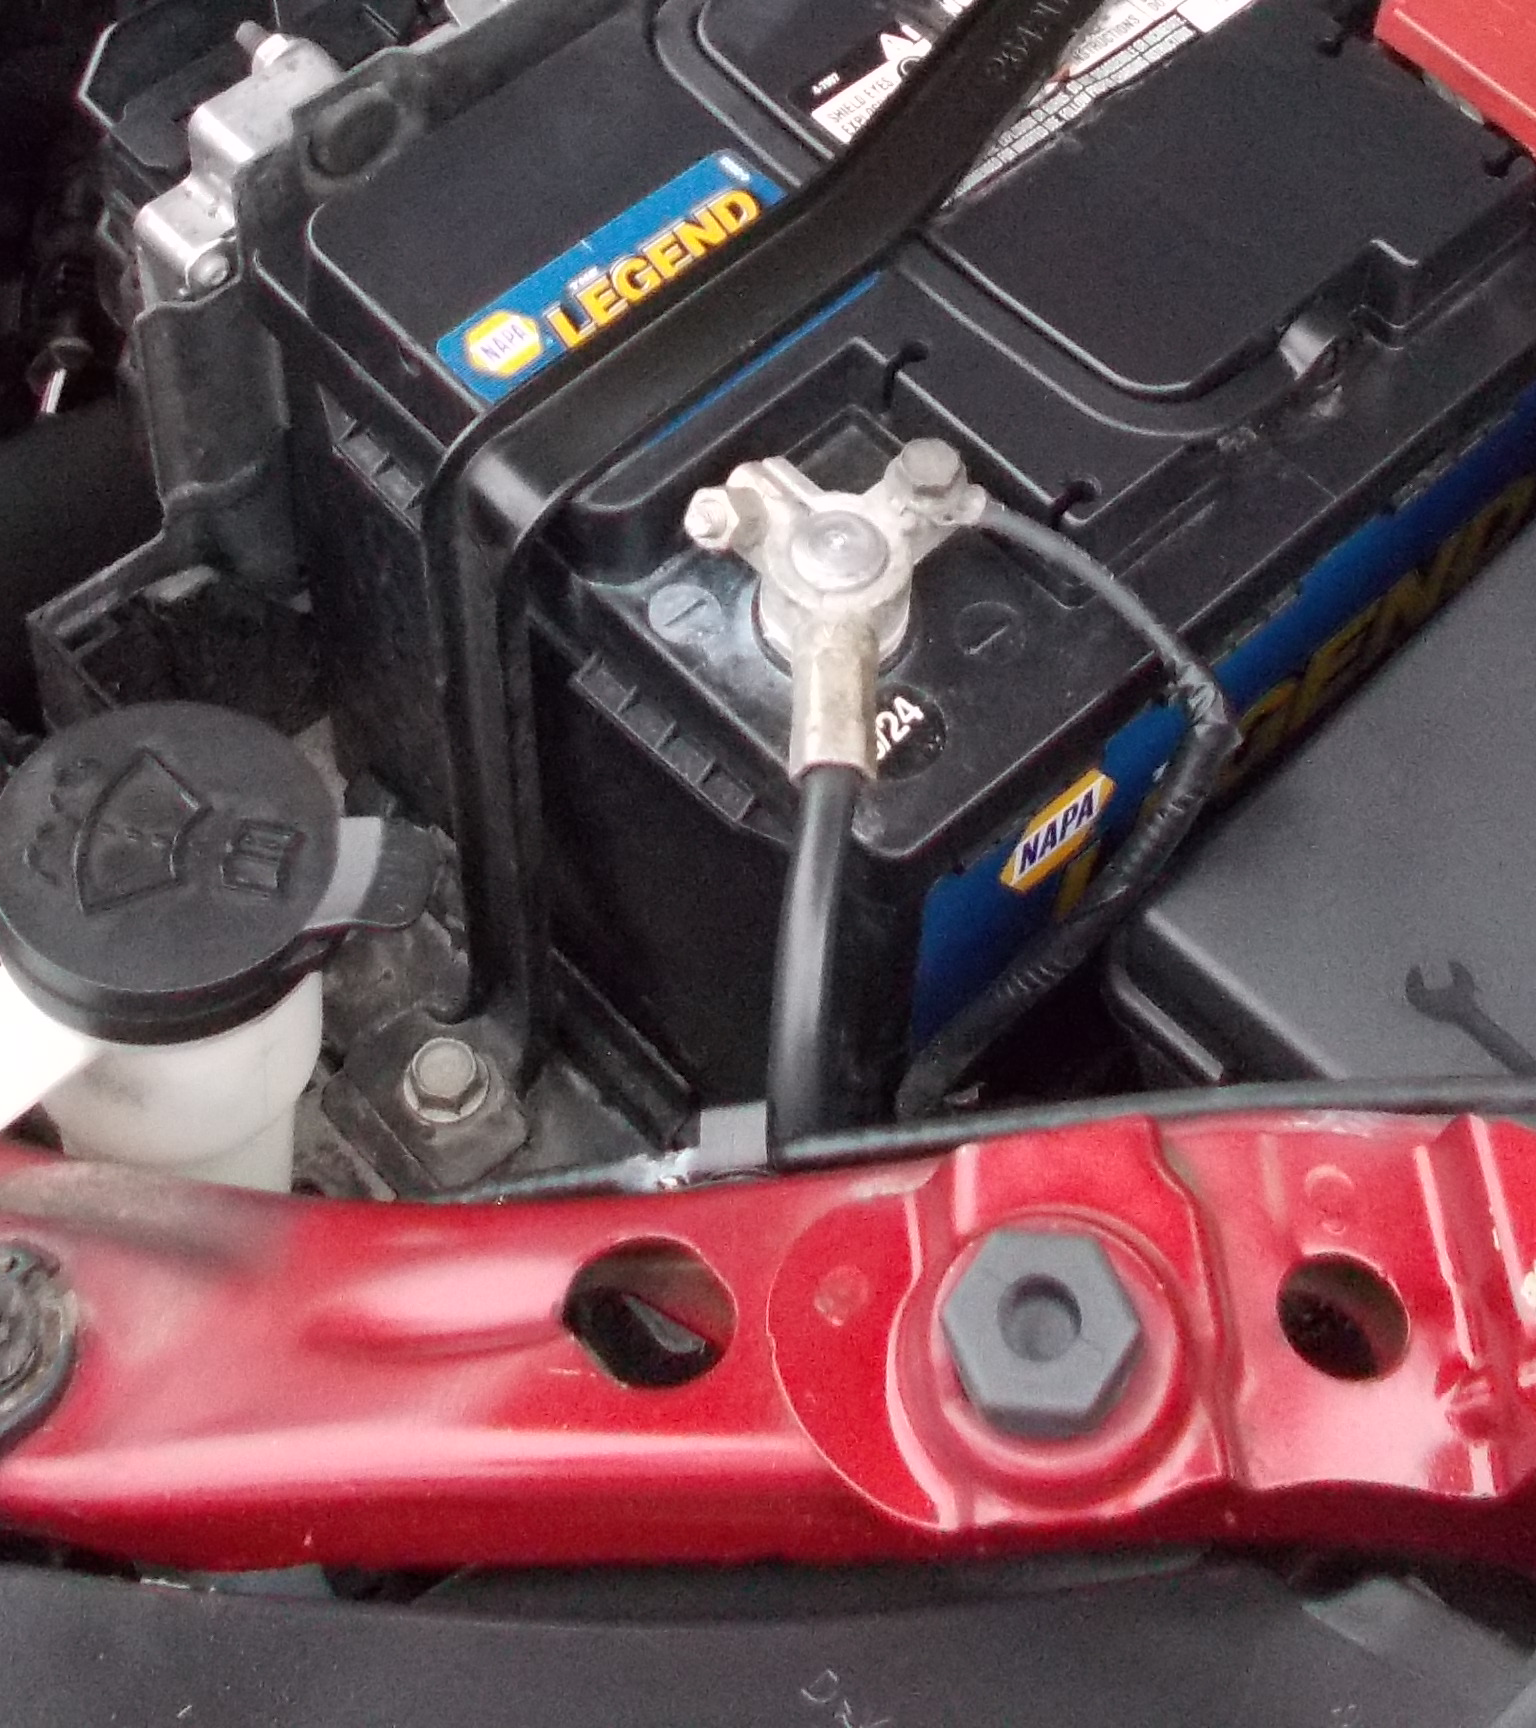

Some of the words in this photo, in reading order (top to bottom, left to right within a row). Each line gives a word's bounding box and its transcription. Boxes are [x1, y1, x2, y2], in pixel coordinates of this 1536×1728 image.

[826, 95, 865, 124] SHIELD
[480, 320, 529, 364] NAPA
[542, 187, 762, 350] LEGEND
[1019, 788, 1094, 875] NAPA
